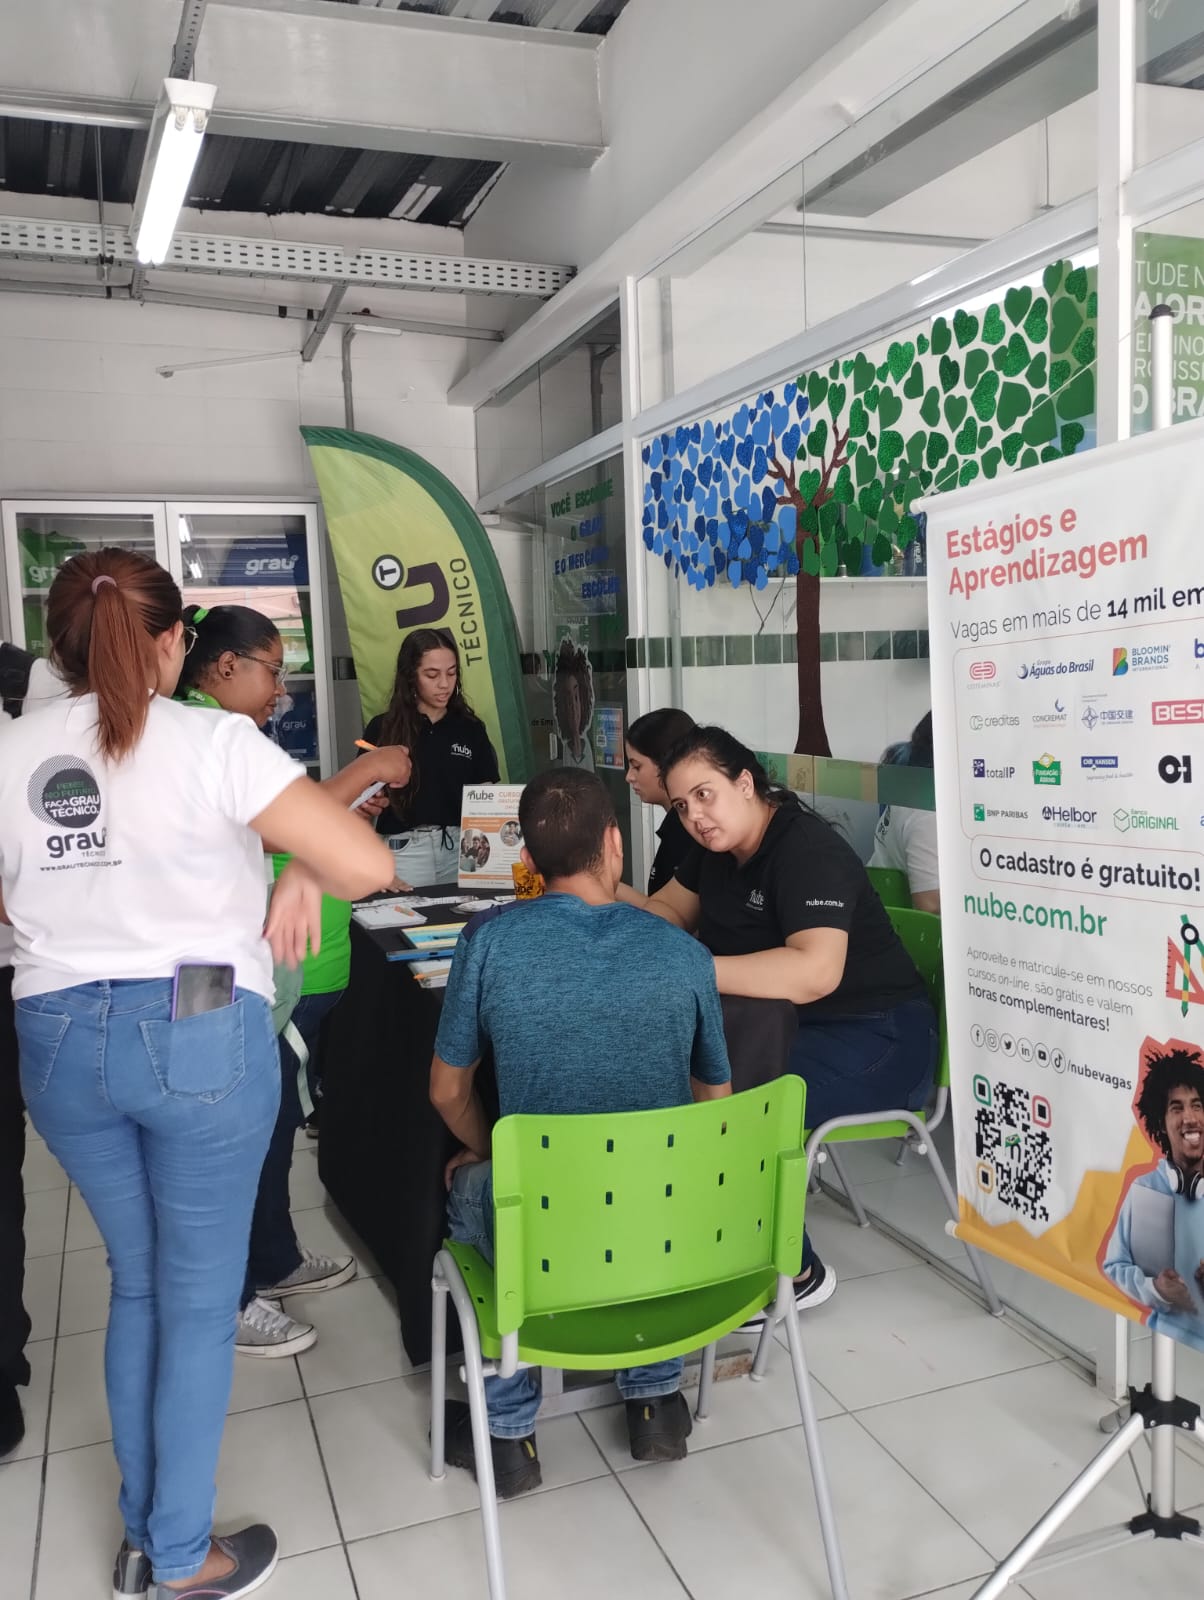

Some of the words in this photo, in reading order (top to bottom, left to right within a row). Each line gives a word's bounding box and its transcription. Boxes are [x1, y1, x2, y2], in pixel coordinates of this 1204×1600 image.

[946, 513, 1053, 560] Estágios
[1060, 508, 1077, 533] e
[245, 554, 298, 575] grau
[949, 534, 1149, 600] Aprendizagem
[450, 557, 482, 667] TÉCNICO
[950, 619, 998, 642] Vagas
[1002, 614, 1028, 633] em
[1032, 603, 1072, 628] mais
[1076, 600, 1102, 622] de
[1106, 598, 1128, 619] 14
[1133, 587, 1166, 615] mil
[1029, 664, 1055, 680] Águas
[1056, 661, 1068, 675] do
[1068, 658, 1095, 674] Brasil
[1131, 655, 1169, 667] BRANDS
[984, 714, 1020, 727] creditas
[986, 766, 1015, 779] totalIP
[69, 794, 100, 807] GRAU
[467, 789, 495, 801] nube
[1001, 809, 1028, 819] PARIBAS
[1052, 806, 1097, 823] Helbor
[1131, 815, 1180, 831] ORIGINAL
[46, 826, 107, 859] grau
[979, 847, 992, 868] O
[996, 851, 1076, 878] cadastro
[1081, 857, 1094, 880] é
[1099, 863, 1201, 892] gratuito!
[964, 891, 1108, 937] nube.com.br
[967, 946, 1009, 969] Aproveite
[1010, 959, 1017, 969] e
[1018, 960, 1084, 984] matricule-se
[1086, 974, 1105, 988] em
[1107, 979, 1153, 998] nossos
[967, 967, 997, 983] cursos
[1034, 981, 1054, 997] são
[1086, 995, 1094, 1007] e
[1096, 996, 1134, 1016] valem
[968, 982, 998, 1002] horas
[999, 993, 1110, 1033] complementares!
[1066, 1061, 1133, 1091] /nubevagas
